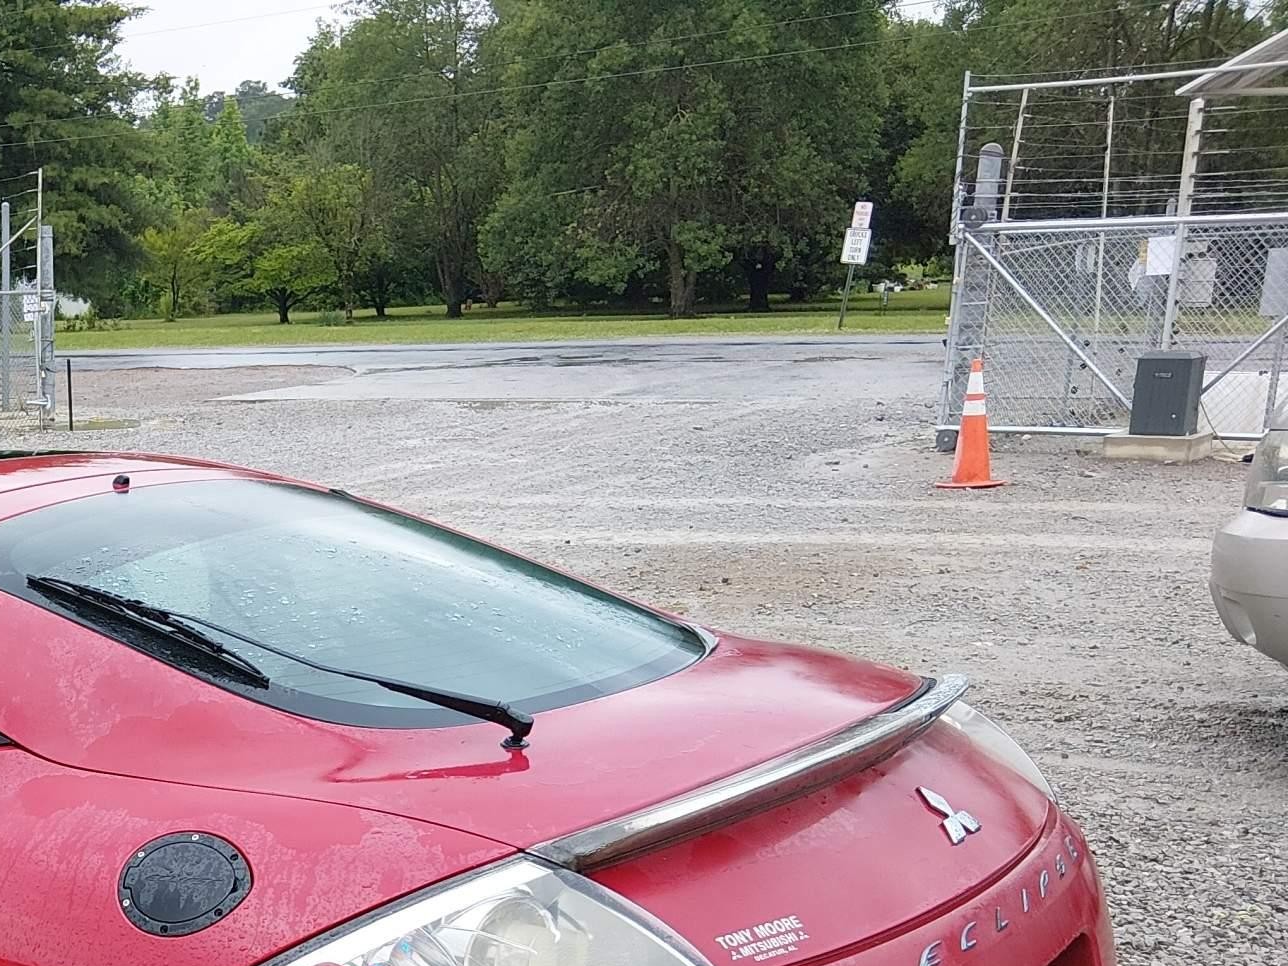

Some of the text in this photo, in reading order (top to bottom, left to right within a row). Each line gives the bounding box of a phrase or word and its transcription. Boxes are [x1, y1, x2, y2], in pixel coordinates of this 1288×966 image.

[715, 915, 803, 949] TONY MOORE
[738, 932, 799, 957] MITSUBISHI
